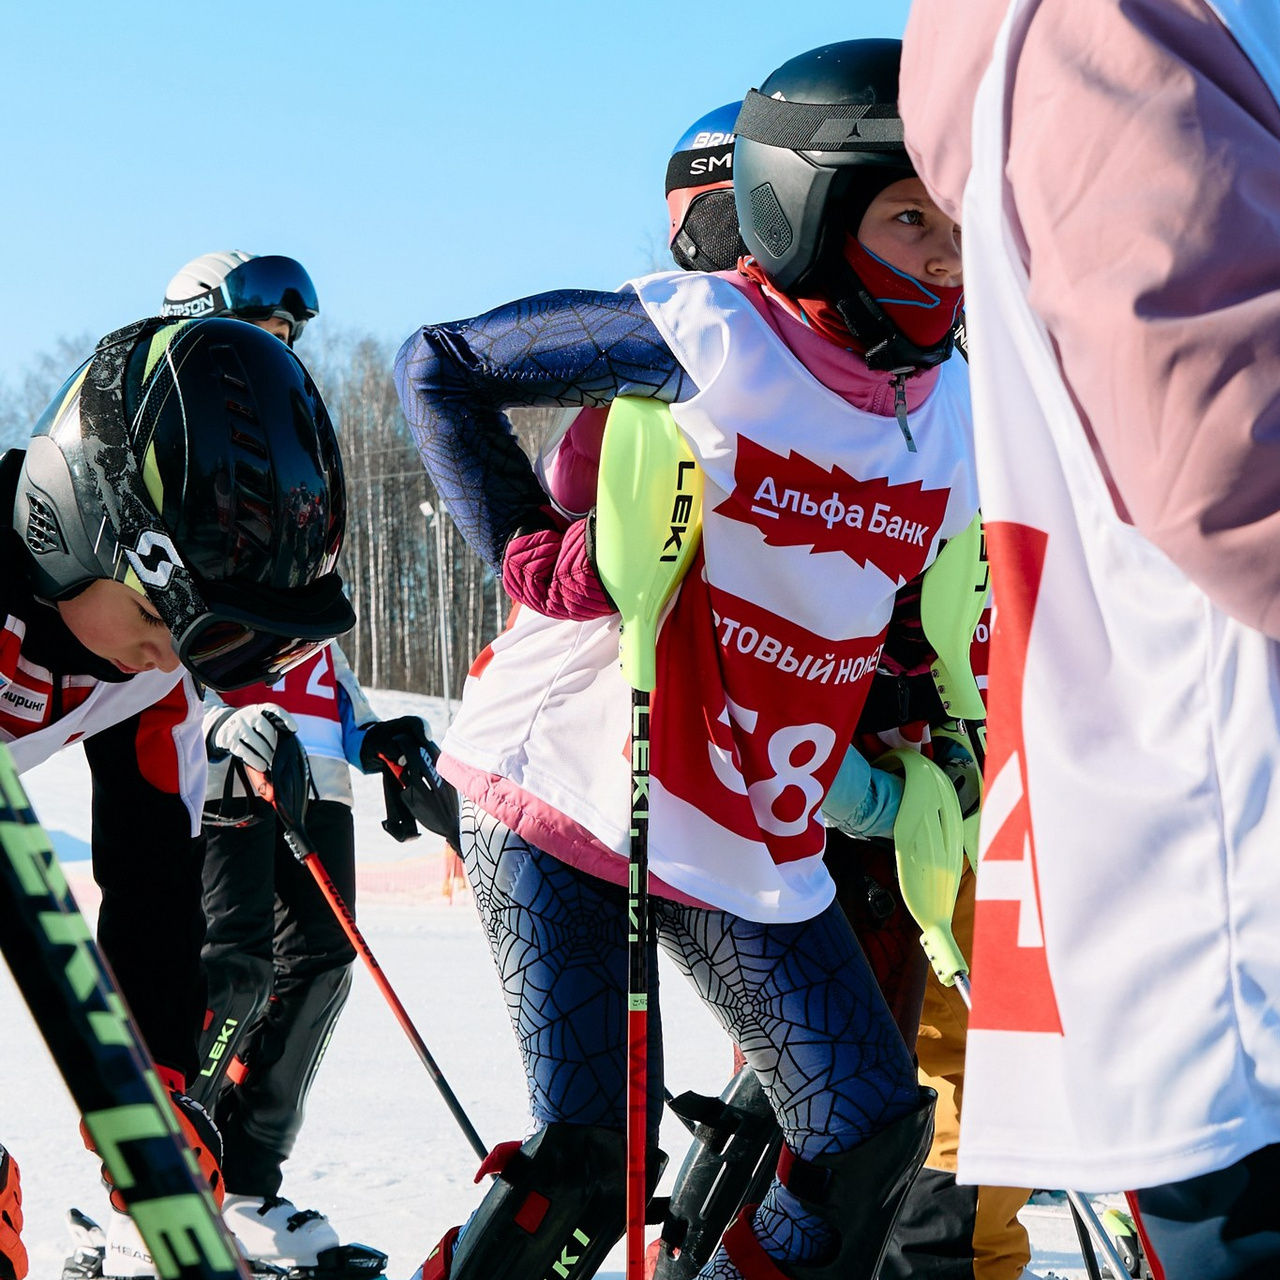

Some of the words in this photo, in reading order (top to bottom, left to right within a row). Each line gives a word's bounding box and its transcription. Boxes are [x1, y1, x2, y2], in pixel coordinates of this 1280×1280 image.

[692, 132, 736, 148] BRI
[659, 460, 695, 562] LEKI
[751, 476, 863, 530] Альфа
[867, 502, 929, 547] Банк
[631, 706, 650, 820] LEKI
[200, 1018, 238, 1077] LEKI
[110, 1243, 153, 1265] HEAD
